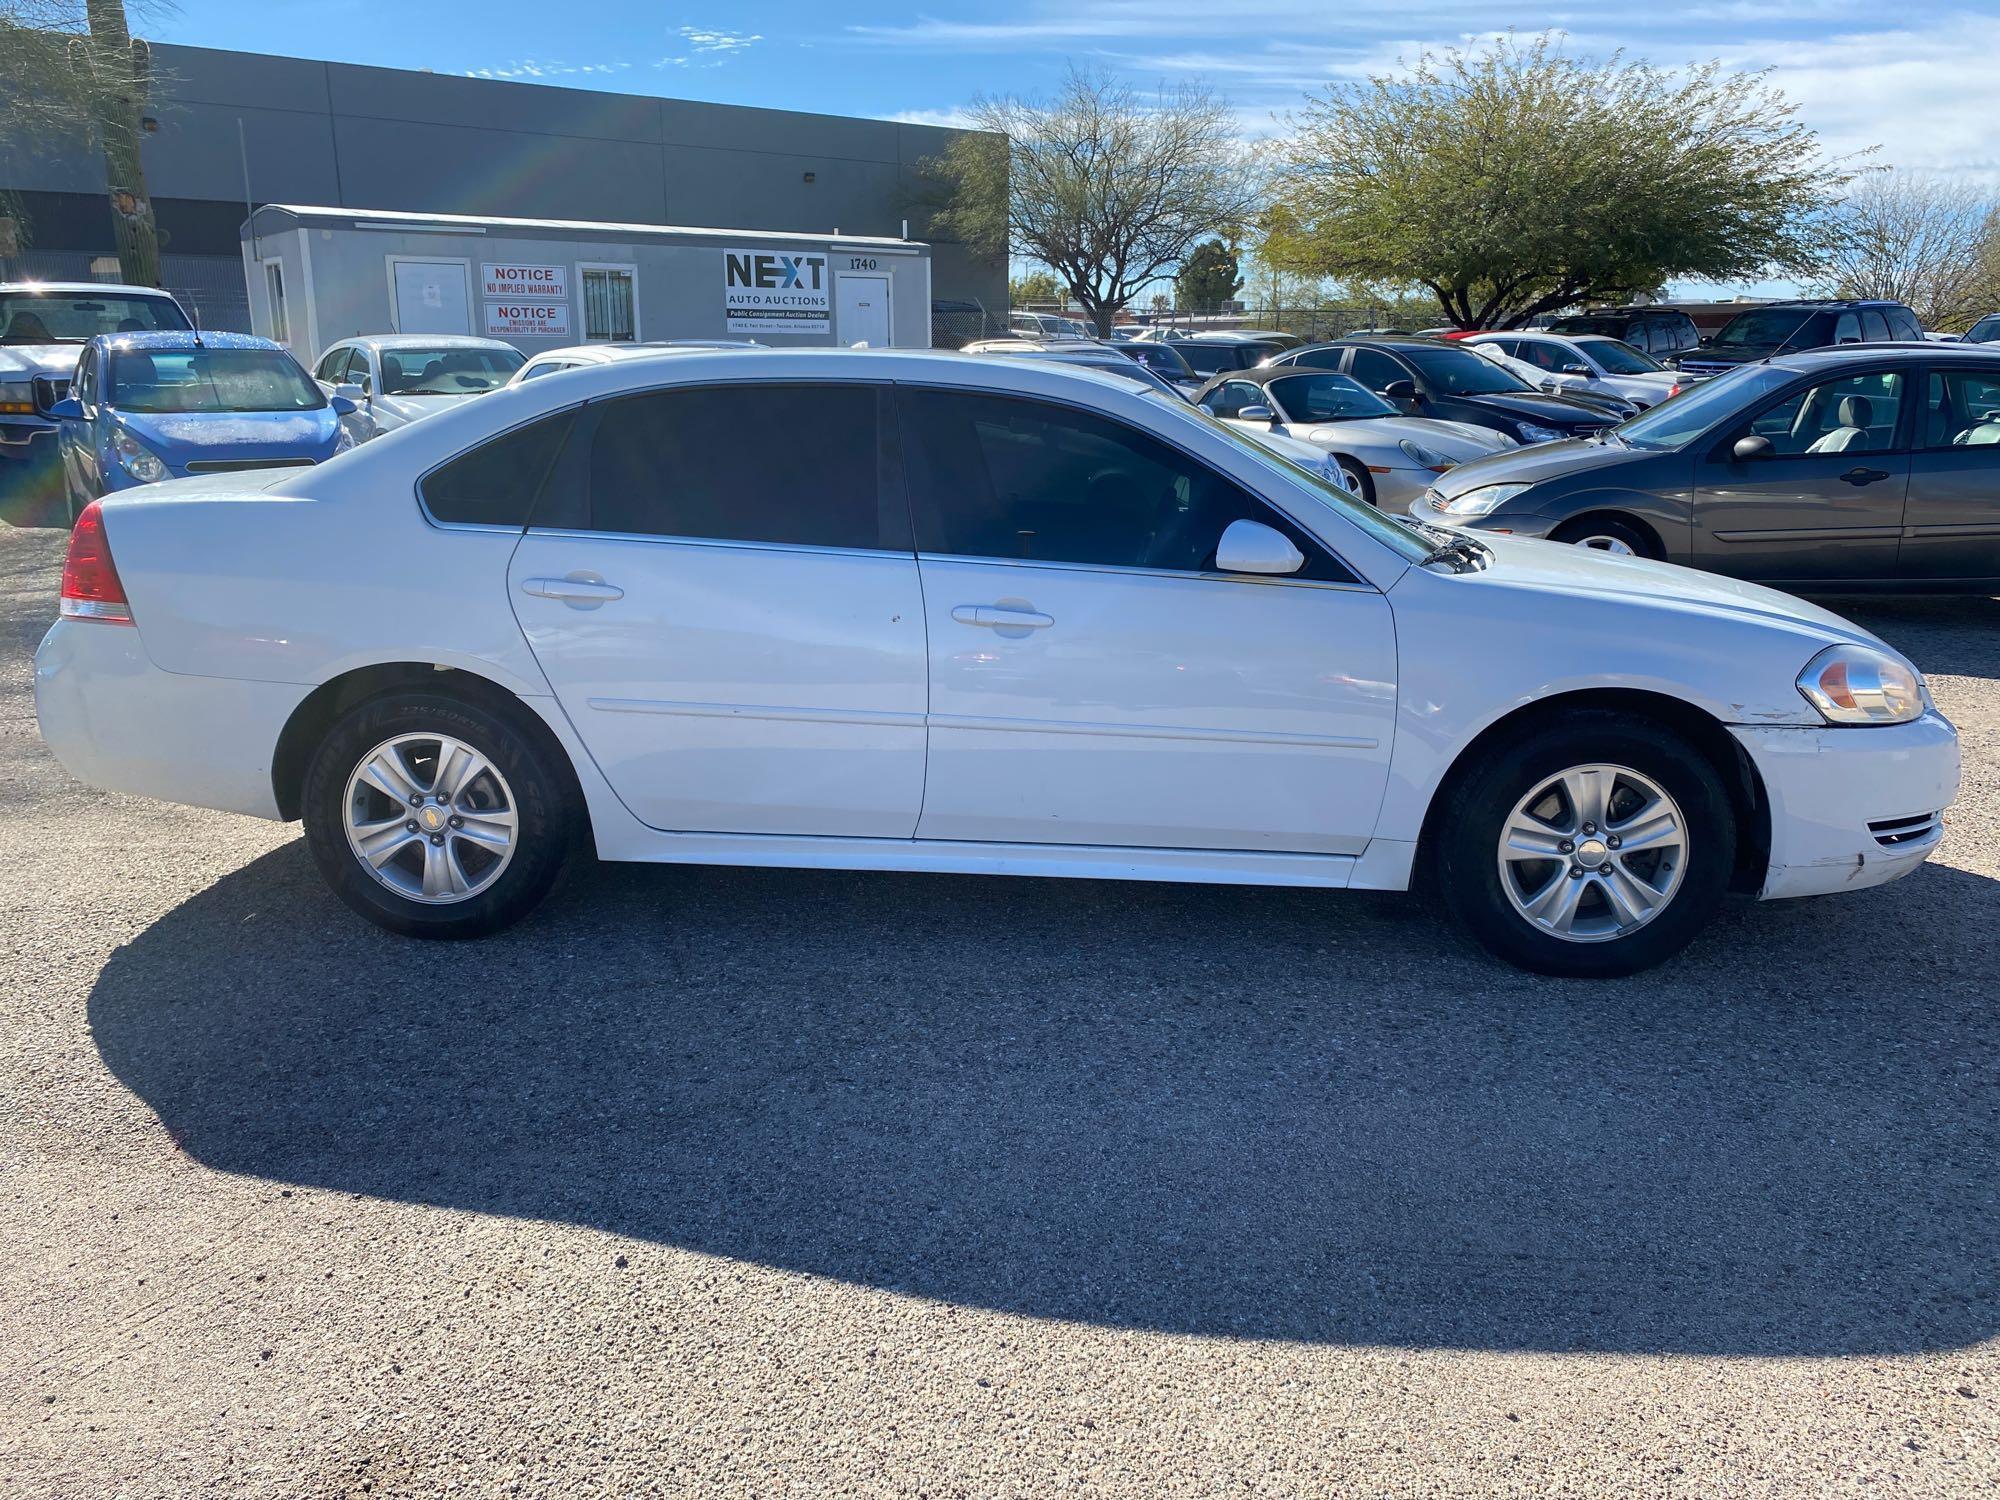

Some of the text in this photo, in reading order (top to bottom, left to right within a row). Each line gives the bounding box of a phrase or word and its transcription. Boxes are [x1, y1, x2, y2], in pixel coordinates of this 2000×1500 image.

[850, 258, 877, 271] 1740
[495, 268, 554, 281] NOTICE
[726, 254, 825, 290] NEXT
[487, 283, 563, 295] NO IMPLIED WARRANTY
[729, 295, 826, 306] AUTO AUCTIONS
[498, 307, 556, 319] NOTICE
[749, 310, 785, 319] Consignment
[807, 311, 826, 319] Dealer
[537, 326, 566, 334] PURCHASER
